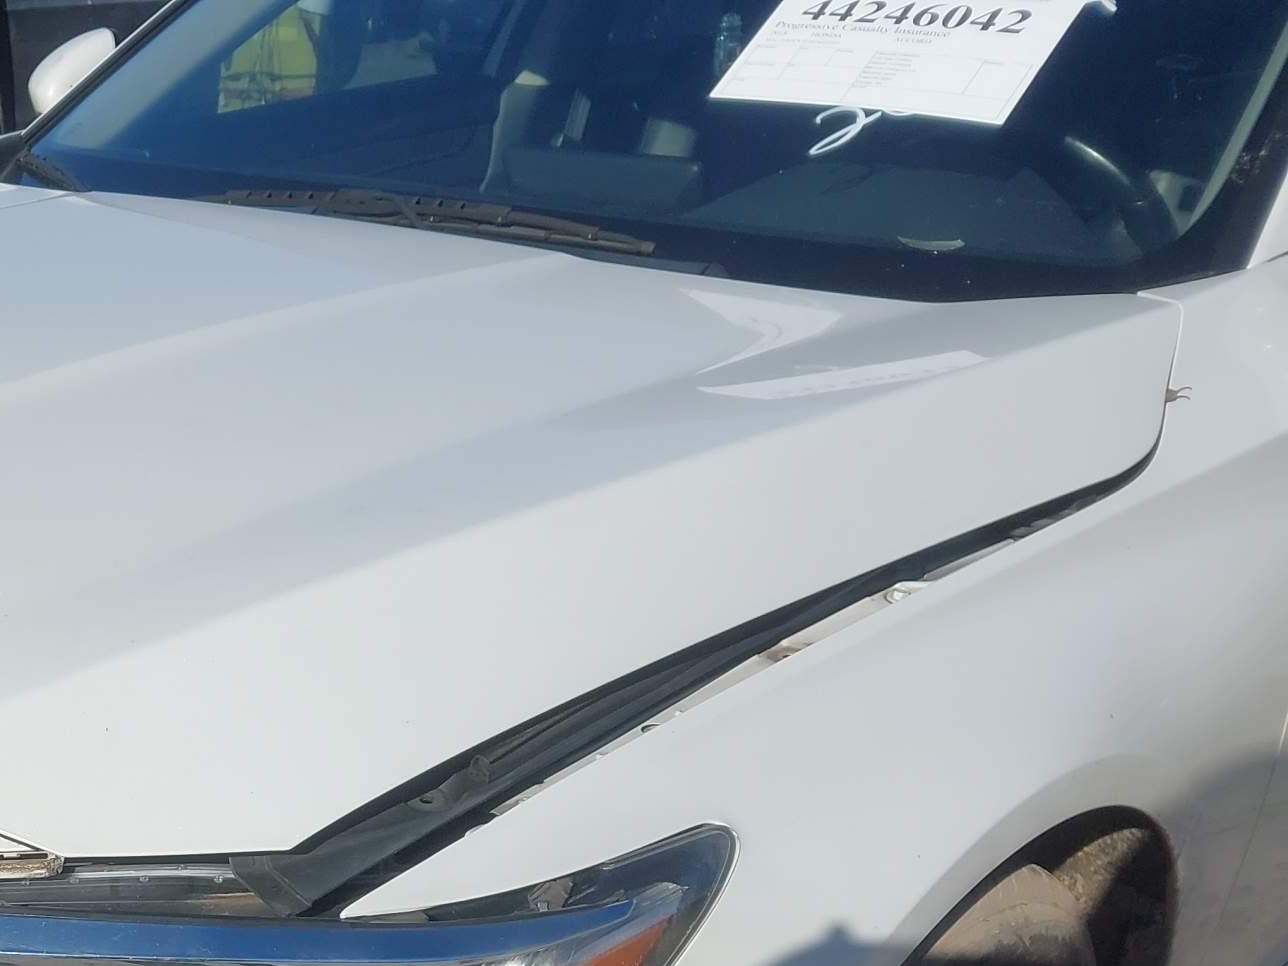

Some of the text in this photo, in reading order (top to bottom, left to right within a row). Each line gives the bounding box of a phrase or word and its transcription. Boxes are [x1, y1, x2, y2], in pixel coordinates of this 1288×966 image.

[775, 20, 840, 34] Progressive
[842, 23, 888, 35] Casualty
[894, 26, 951, 38] Insurance
[802, 0, 1032, 34] 44246042
